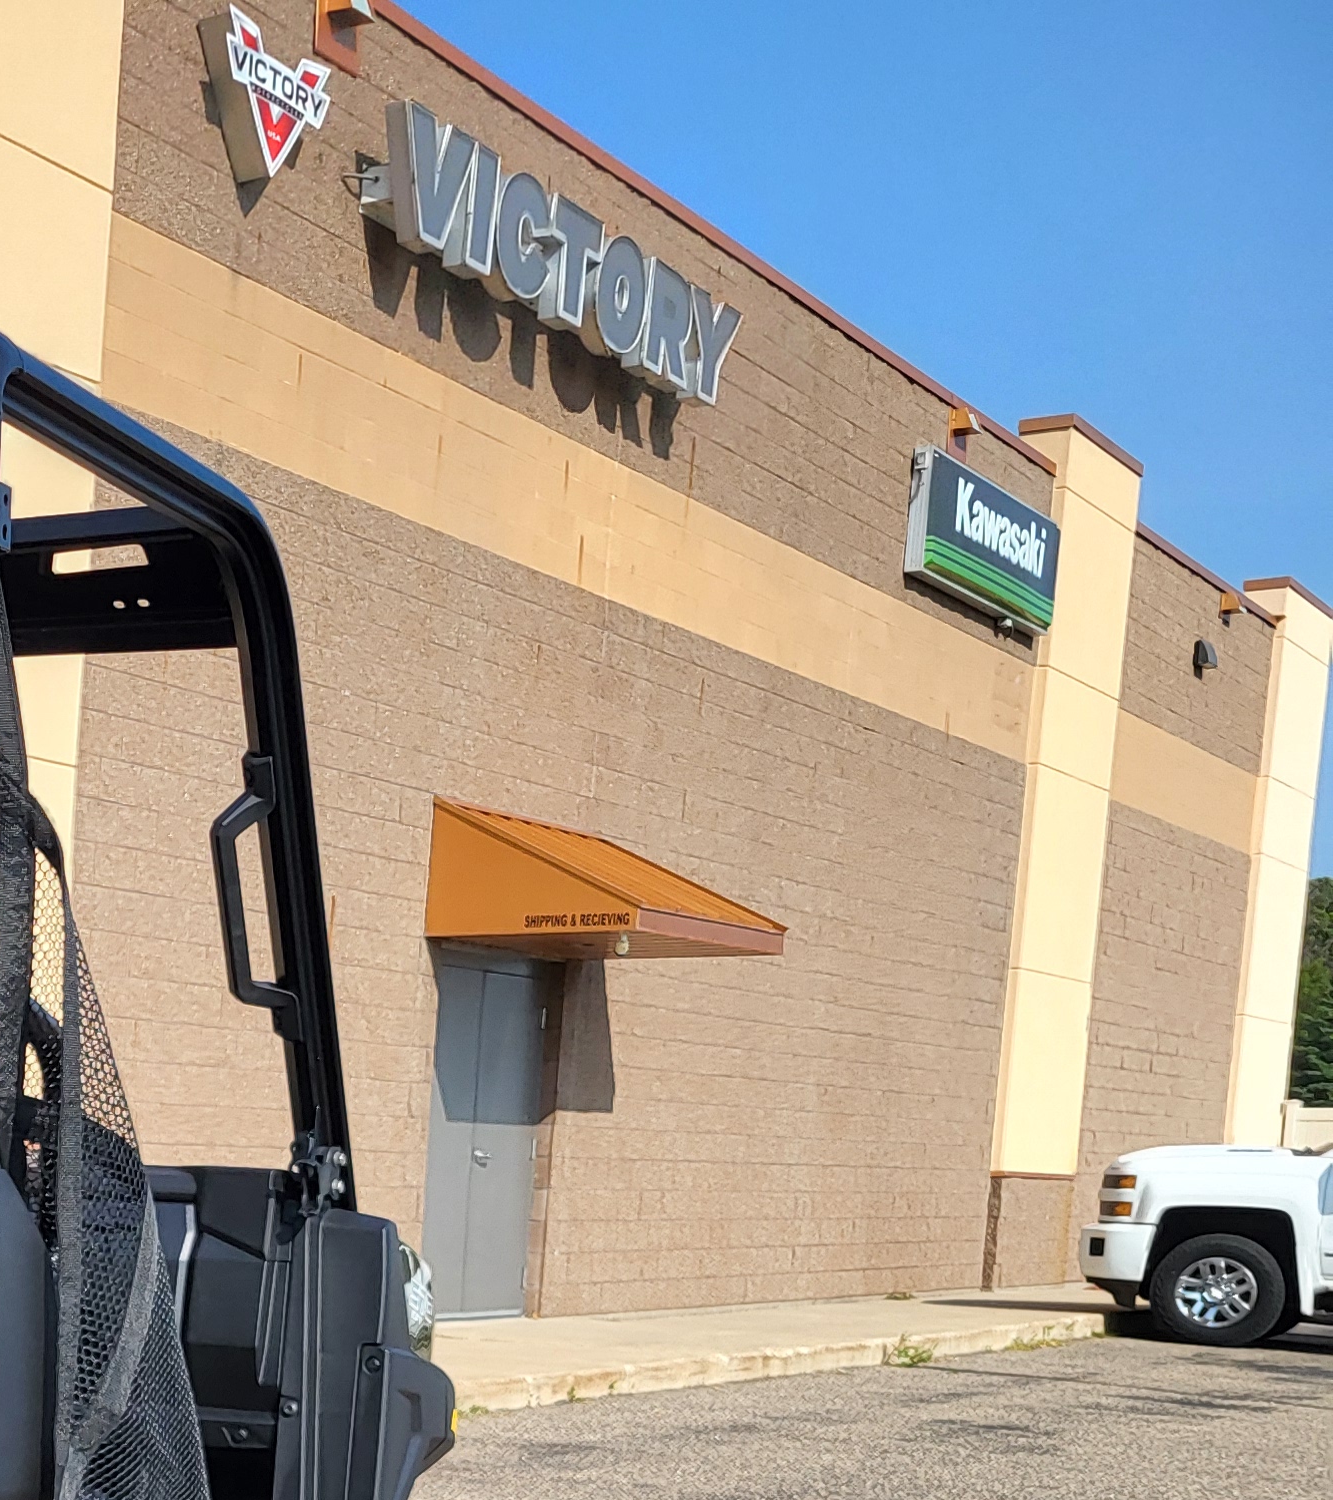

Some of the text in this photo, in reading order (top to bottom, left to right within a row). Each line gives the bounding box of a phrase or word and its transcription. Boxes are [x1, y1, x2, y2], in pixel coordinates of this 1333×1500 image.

[233, 45, 323, 119] VICTORY
[267, 130, 282, 143] USA
[403, 98, 743, 407] VICTORY
[955, 476, 1048, 579] Kawasaki
[524, 912, 630, 929] SHIPPING & RECIEVING
